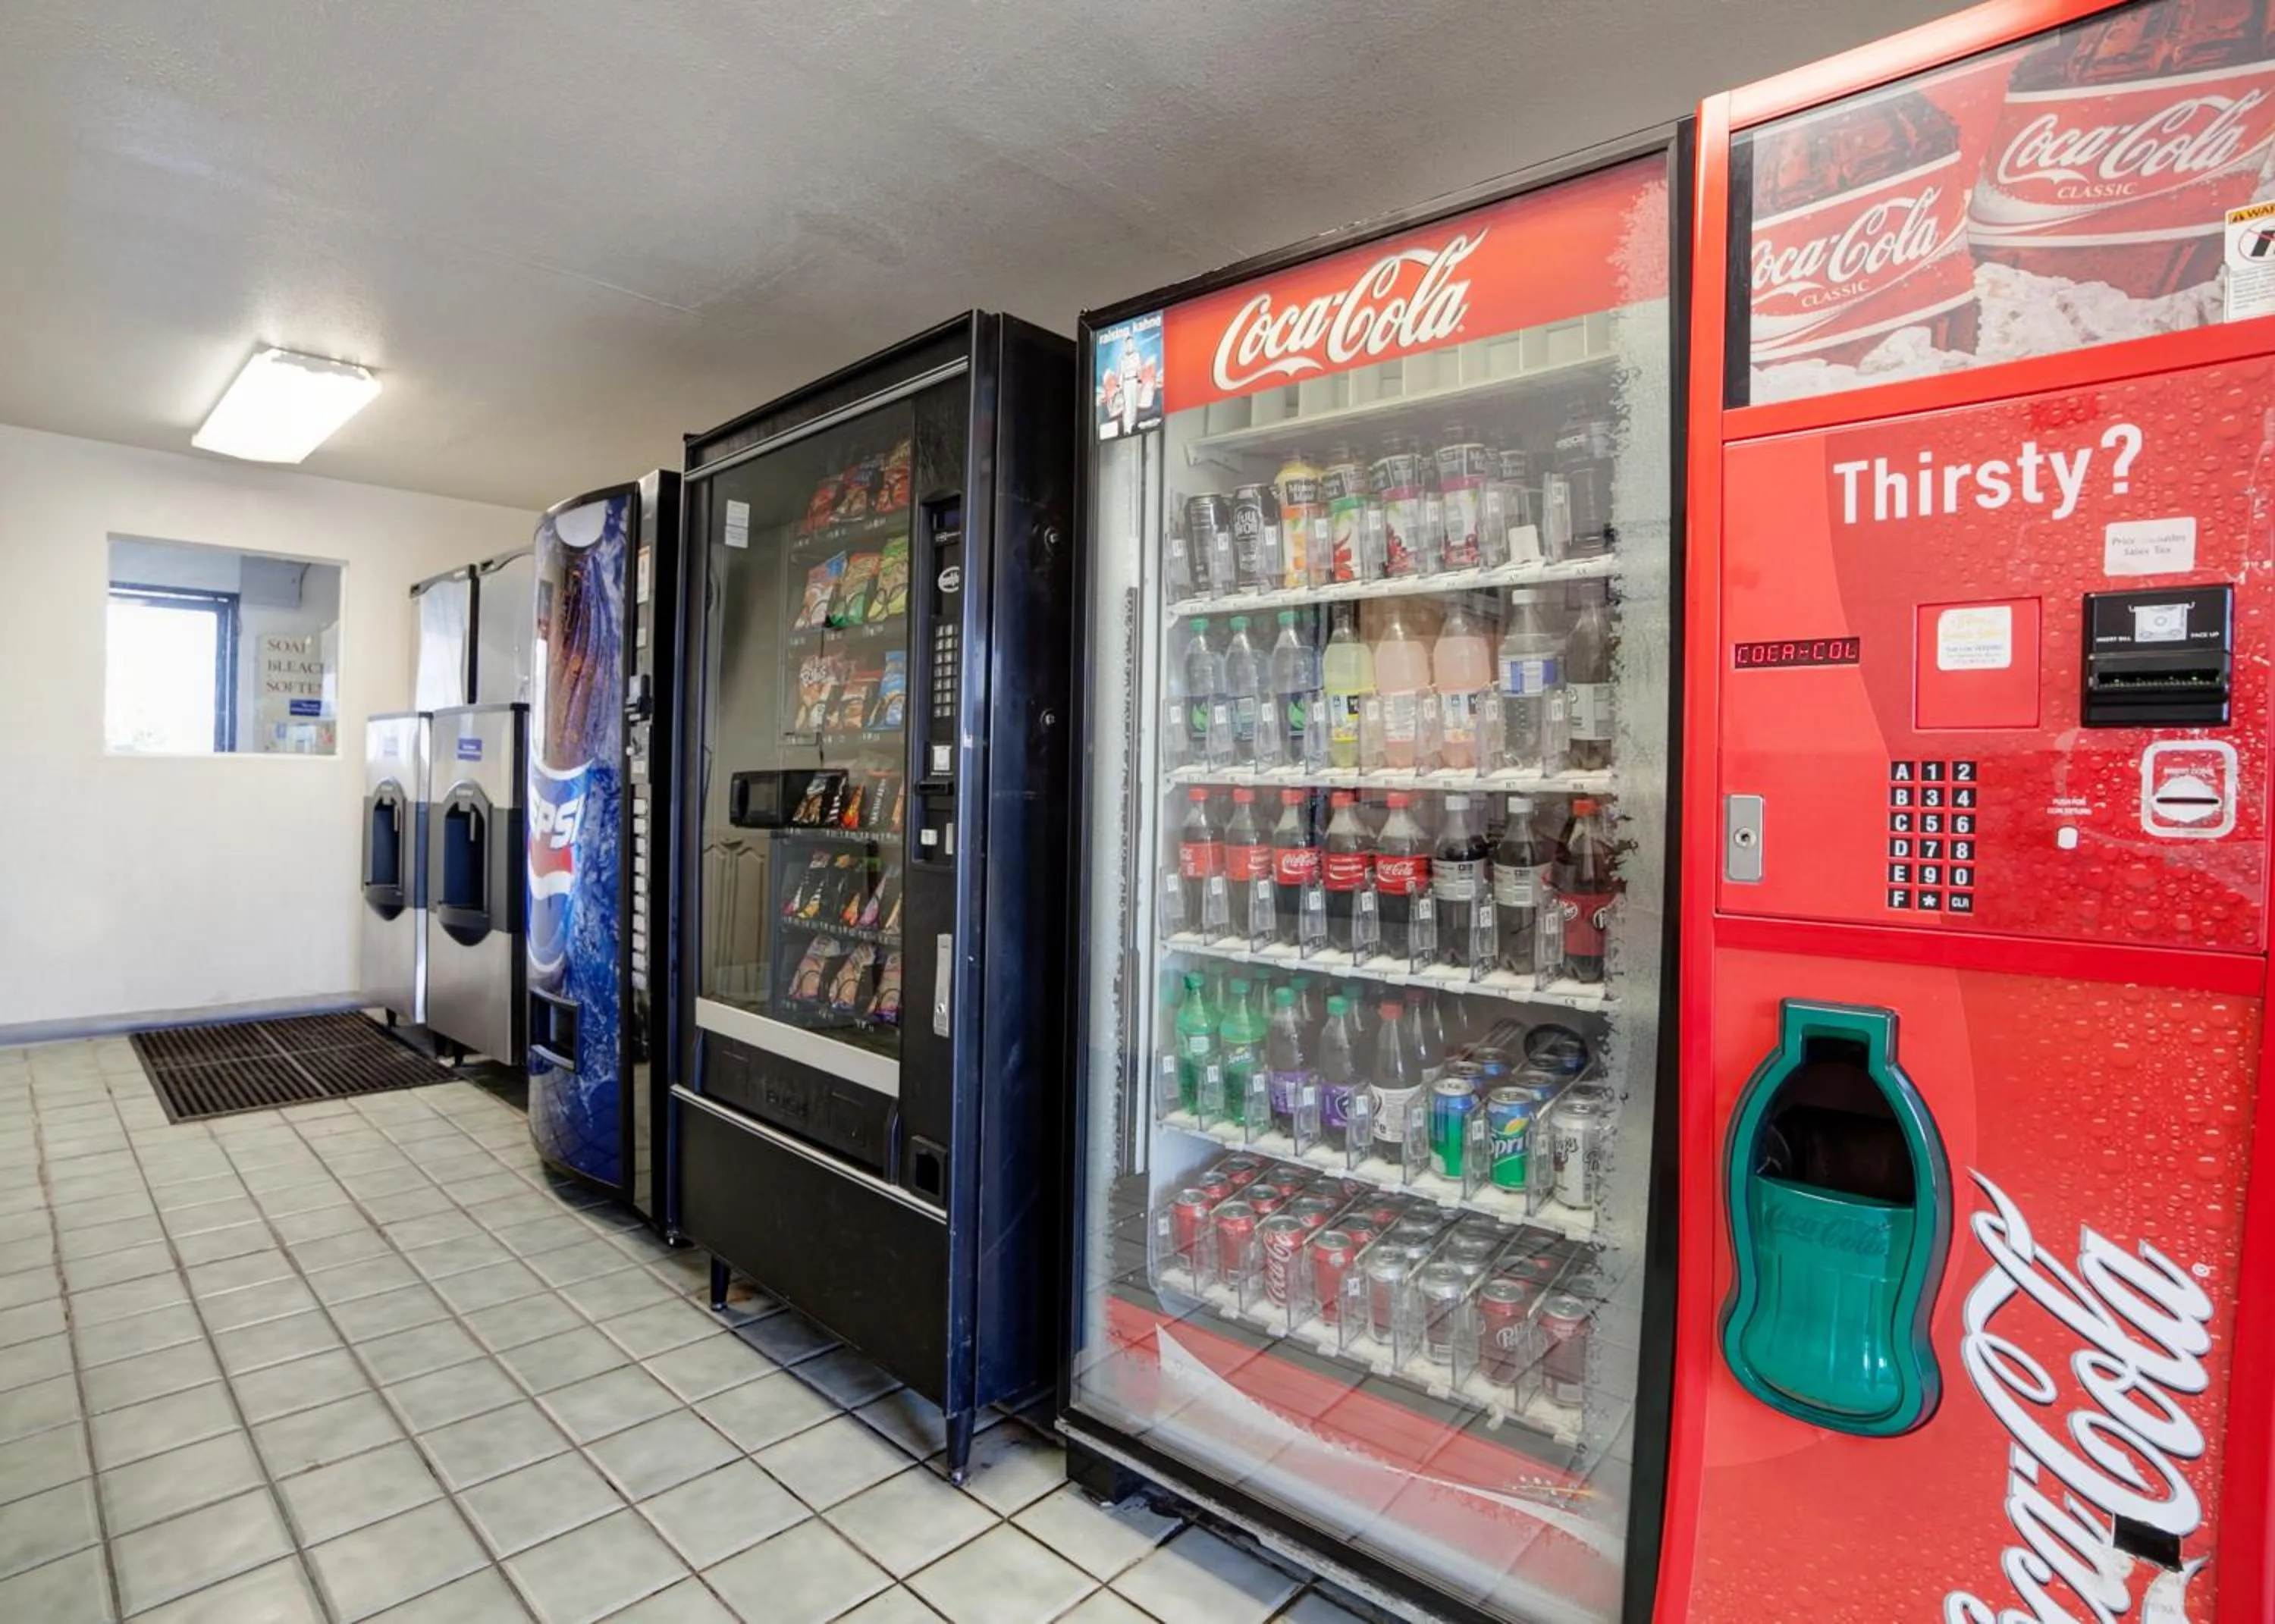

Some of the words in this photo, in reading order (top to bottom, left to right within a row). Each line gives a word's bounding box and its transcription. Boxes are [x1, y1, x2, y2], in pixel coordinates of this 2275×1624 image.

[1997, 88, 2273, 184] Coca-Cola
[2057, 181, 2138, 199] CLASSIC
[1801, 278, 1871, 308] CLASSIC
[1213, 227, 1491, 391] Coca-Cola
[1832, 423, 2143, 524] Thirsty?
[1895, 763, 1909, 780] A
[1927, 763, 1937, 780] 1
[1957, 763, 1971, 780] 2
[1895, 789, 1908, 806] B
[1926, 789, 1938, 806] 3
[1956, 790, 1969, 807] 4
[530, 785, 587, 850] EPSI
[1895, 814, 1908, 832] C
[1925, 815, 1938, 832] 5
[1956, 817, 1969, 833] 6
[1894, 840, 1907, 856] D
[1925, 842, 1937, 857] 7
[1956, 842, 1968, 859] 8
[1894, 866, 1906, 882] E
[1925, 867, 1937, 883] 9
[1955, 868, 1968, 885] 0
[1893, 891, 1905, 907] F
[1951, 896, 1969, 908] CLR
[1943, 1165, 2212, 1624] ca-Cola
